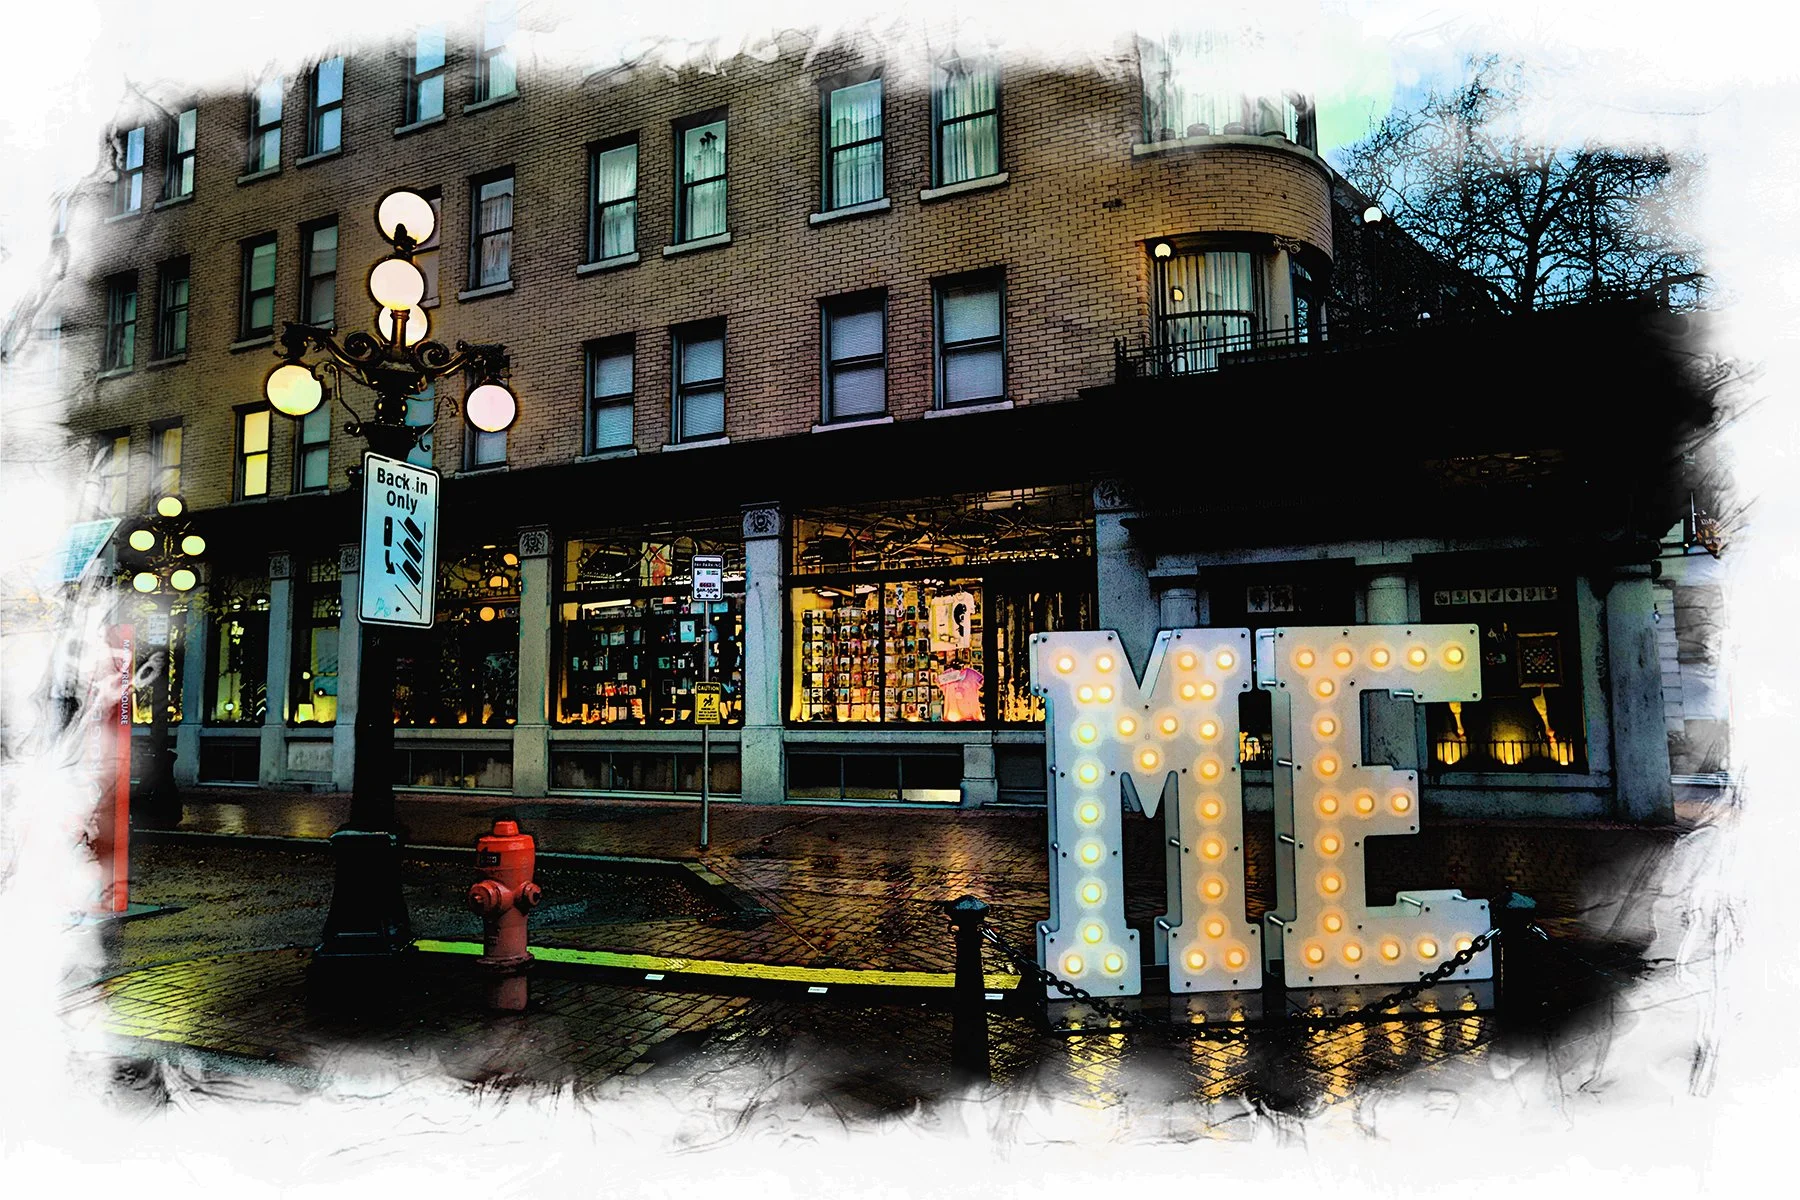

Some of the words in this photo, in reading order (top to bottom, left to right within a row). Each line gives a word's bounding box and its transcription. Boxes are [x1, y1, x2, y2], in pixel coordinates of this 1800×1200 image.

[376, 467, 410, 491] Back
[415, 477, 428, 496] in
[386, 490, 418, 515] Only
[120, 691, 129, 725] SQUARE
[1029, 624, 1494, 999] ME
